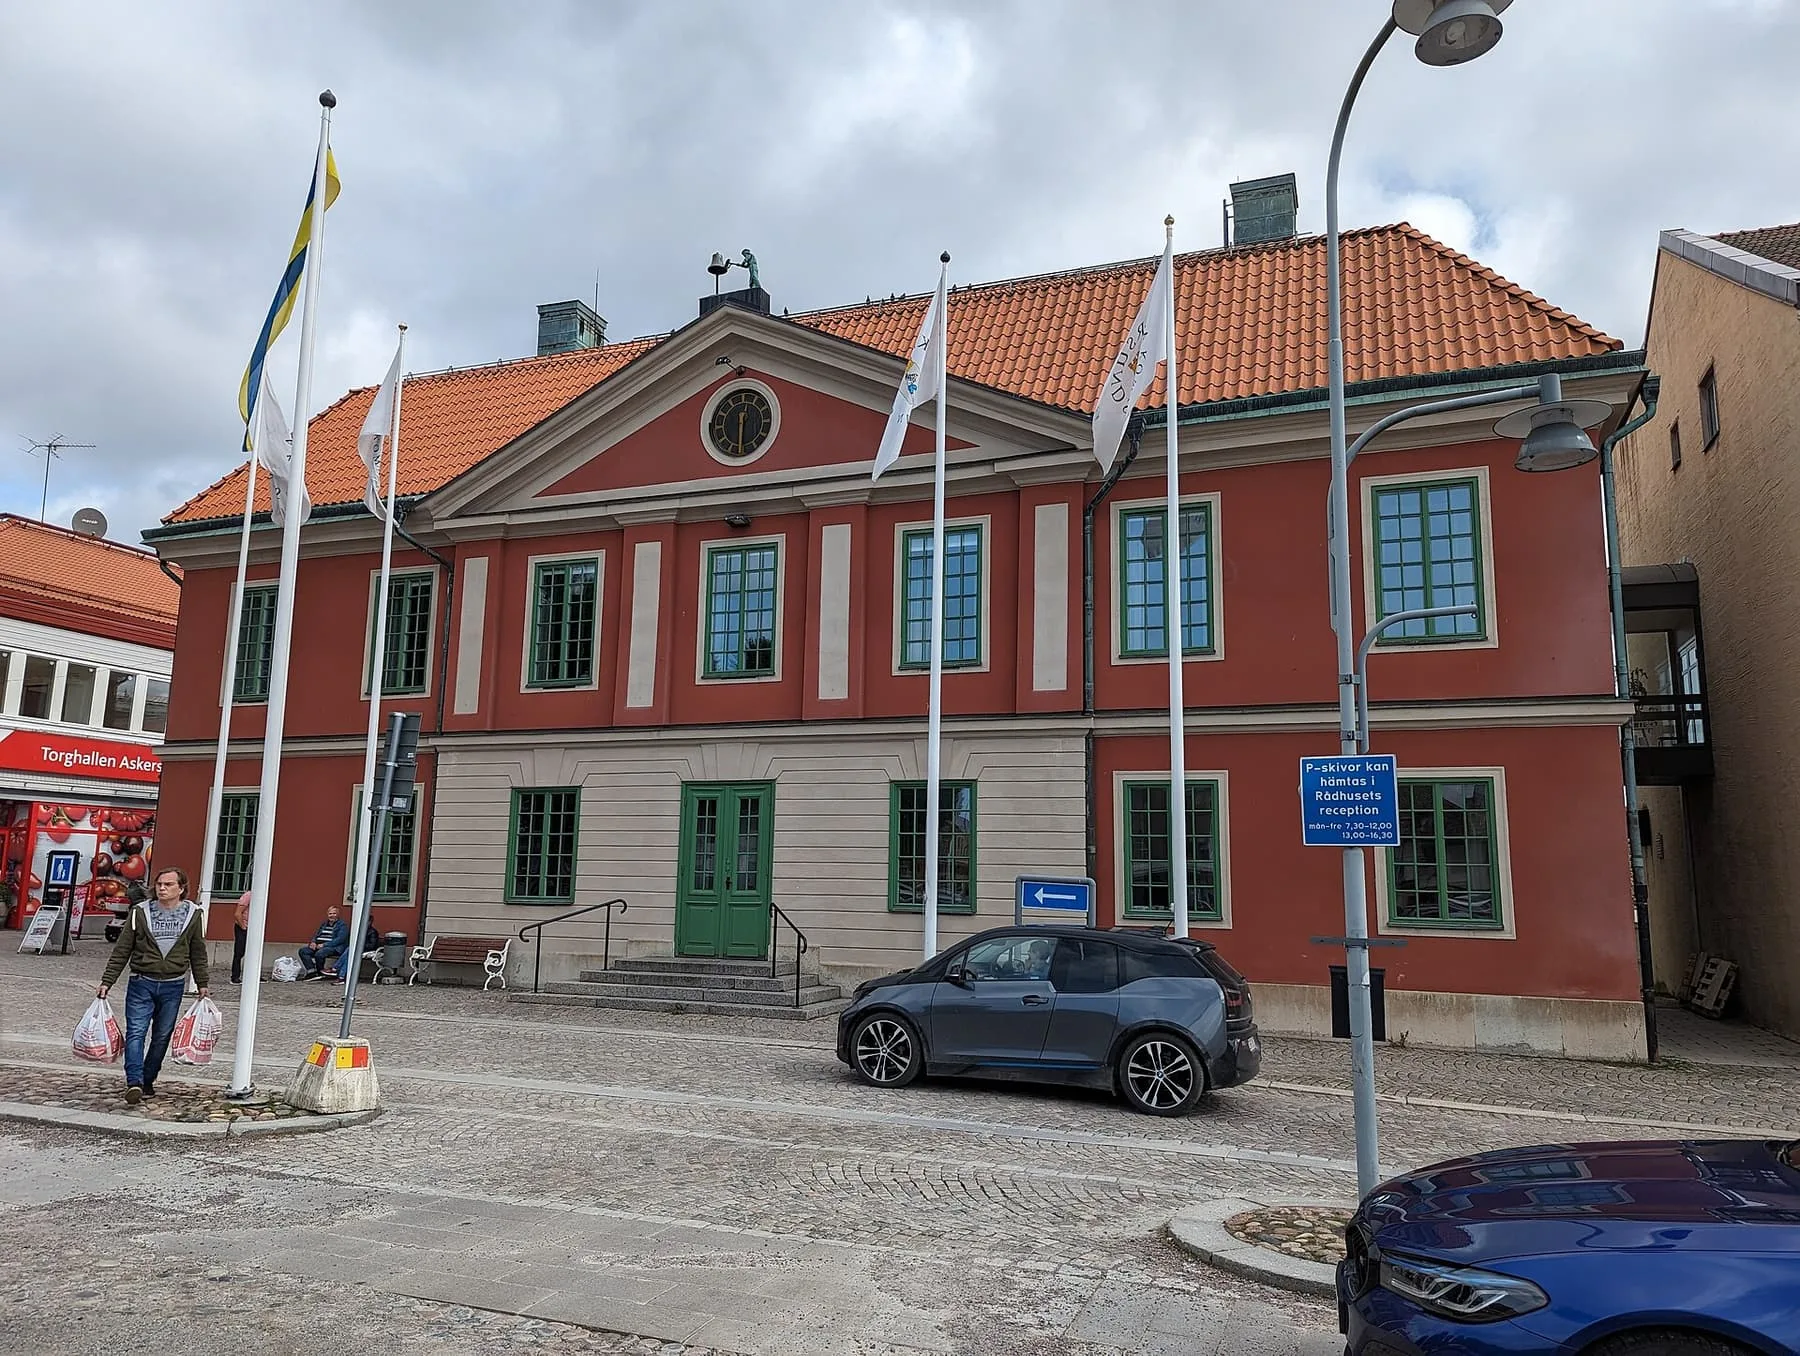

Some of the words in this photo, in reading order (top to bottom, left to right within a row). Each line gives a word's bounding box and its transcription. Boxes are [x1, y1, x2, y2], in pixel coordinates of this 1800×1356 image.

[41, 747, 116, 767] Torghallen
[1306, 762, 1361, 773] P-skivor
[1366, 762, 1389, 772] kan
[1320, 777, 1367, 787] hämtas
[1315, 791, 1382, 801] Rådhusets
[1319, 805, 1379, 817] reception
[1308, 822, 1342, 830] mån-fre
[154, 921, 179, 931] DENIM
